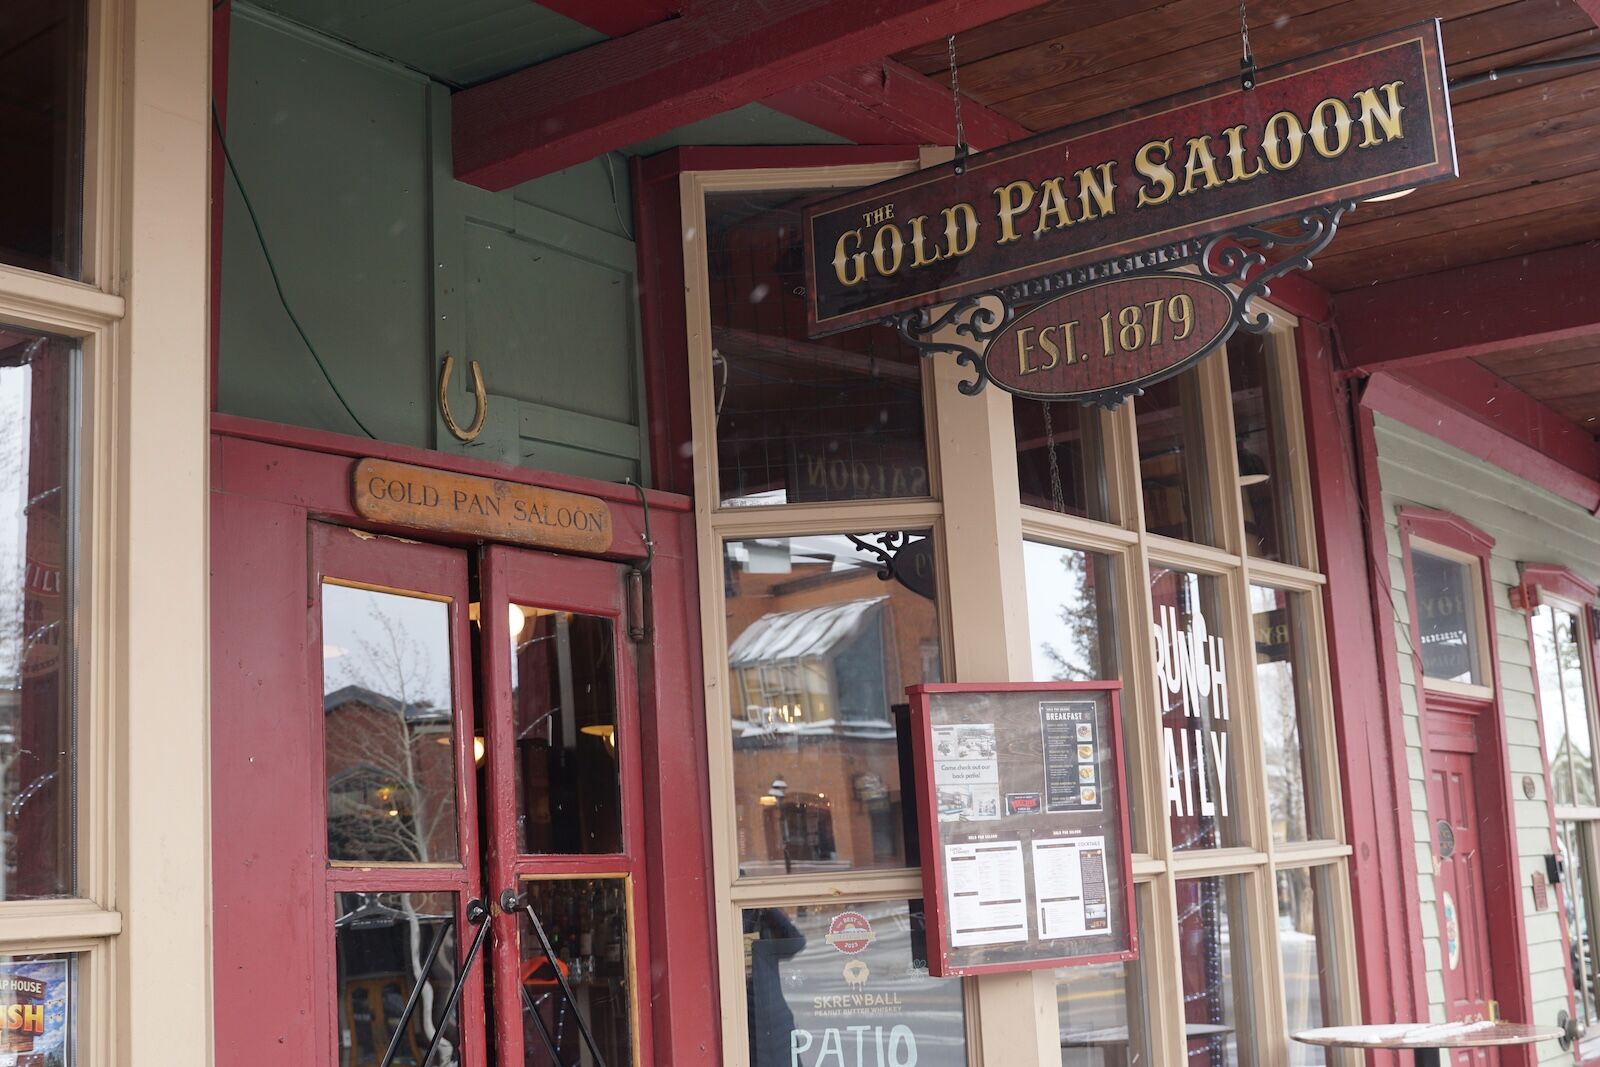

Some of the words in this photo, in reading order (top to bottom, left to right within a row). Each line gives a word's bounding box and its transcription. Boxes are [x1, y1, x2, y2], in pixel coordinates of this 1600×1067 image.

[831, 201, 981, 287] GOLD
[993, 161, 1118, 246] PAN
[1133, 81, 1405, 210] SALOON
[863, 203, 895, 229] THE
[1016, 323, 1090, 377] EST.
[1100, 292, 1194, 356] 1879
[368, 476, 439, 508] GOLD
[453, 490, 500, 516] PAN
[513, 499, 603, 532] SALOON
[1154, 605, 1230, 721] RUNCH
[1045, 712, 1082, 721] BREAKFAST
[1164, 727, 1229, 817] AILY
[10, 980, 42, 993] HOUSE
[814, 992, 902, 1009] SKREWBALL
[814, 1009, 841, 1017] PEANUT
[843, 1007, 870, 1016] BUTTER
[870, 1006, 902, 1014] WHISKEY
[791, 1024, 918, 1067] PATIO
